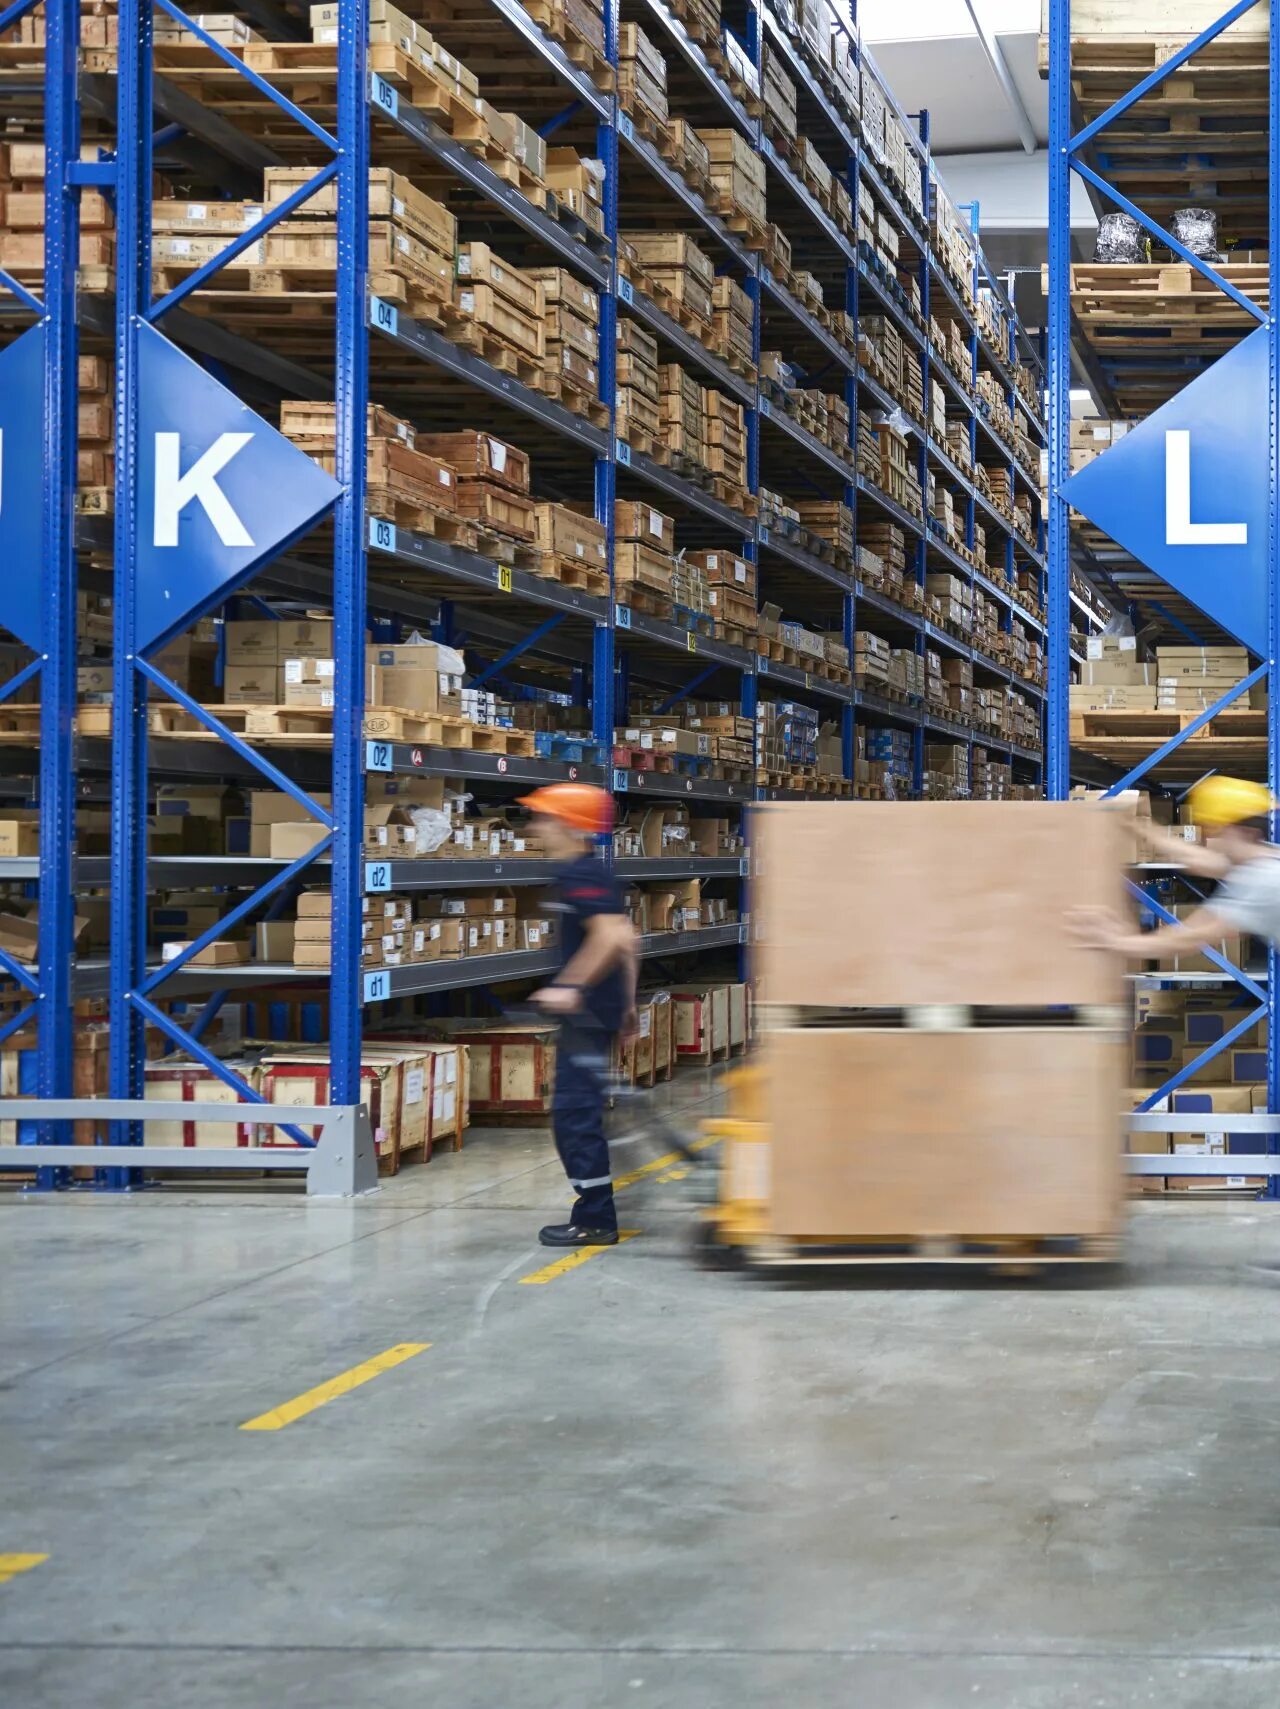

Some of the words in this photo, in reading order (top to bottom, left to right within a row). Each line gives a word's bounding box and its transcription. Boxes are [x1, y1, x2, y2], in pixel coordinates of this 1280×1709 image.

[379, 81, 392, 109] 05
[622, 281, 630, 300] 05
[378, 303, 391, 329] 04
[620, 443, 627, 462] 04
[154, 433, 255, 547] K
[1165, 430, 1248, 545] L
[377, 523, 390, 547] 03
[501, 568, 510, 588] 01
[620, 608, 628, 625] 03
[370, 720, 385, 730] EUR
[373, 745, 387, 767] 02
[415, 750, 422, 762] A
[500, 760, 507, 772] B
[617, 772, 625, 788] 02
[372, 866, 385, 887] d2
[371, 976, 383, 997] d1
